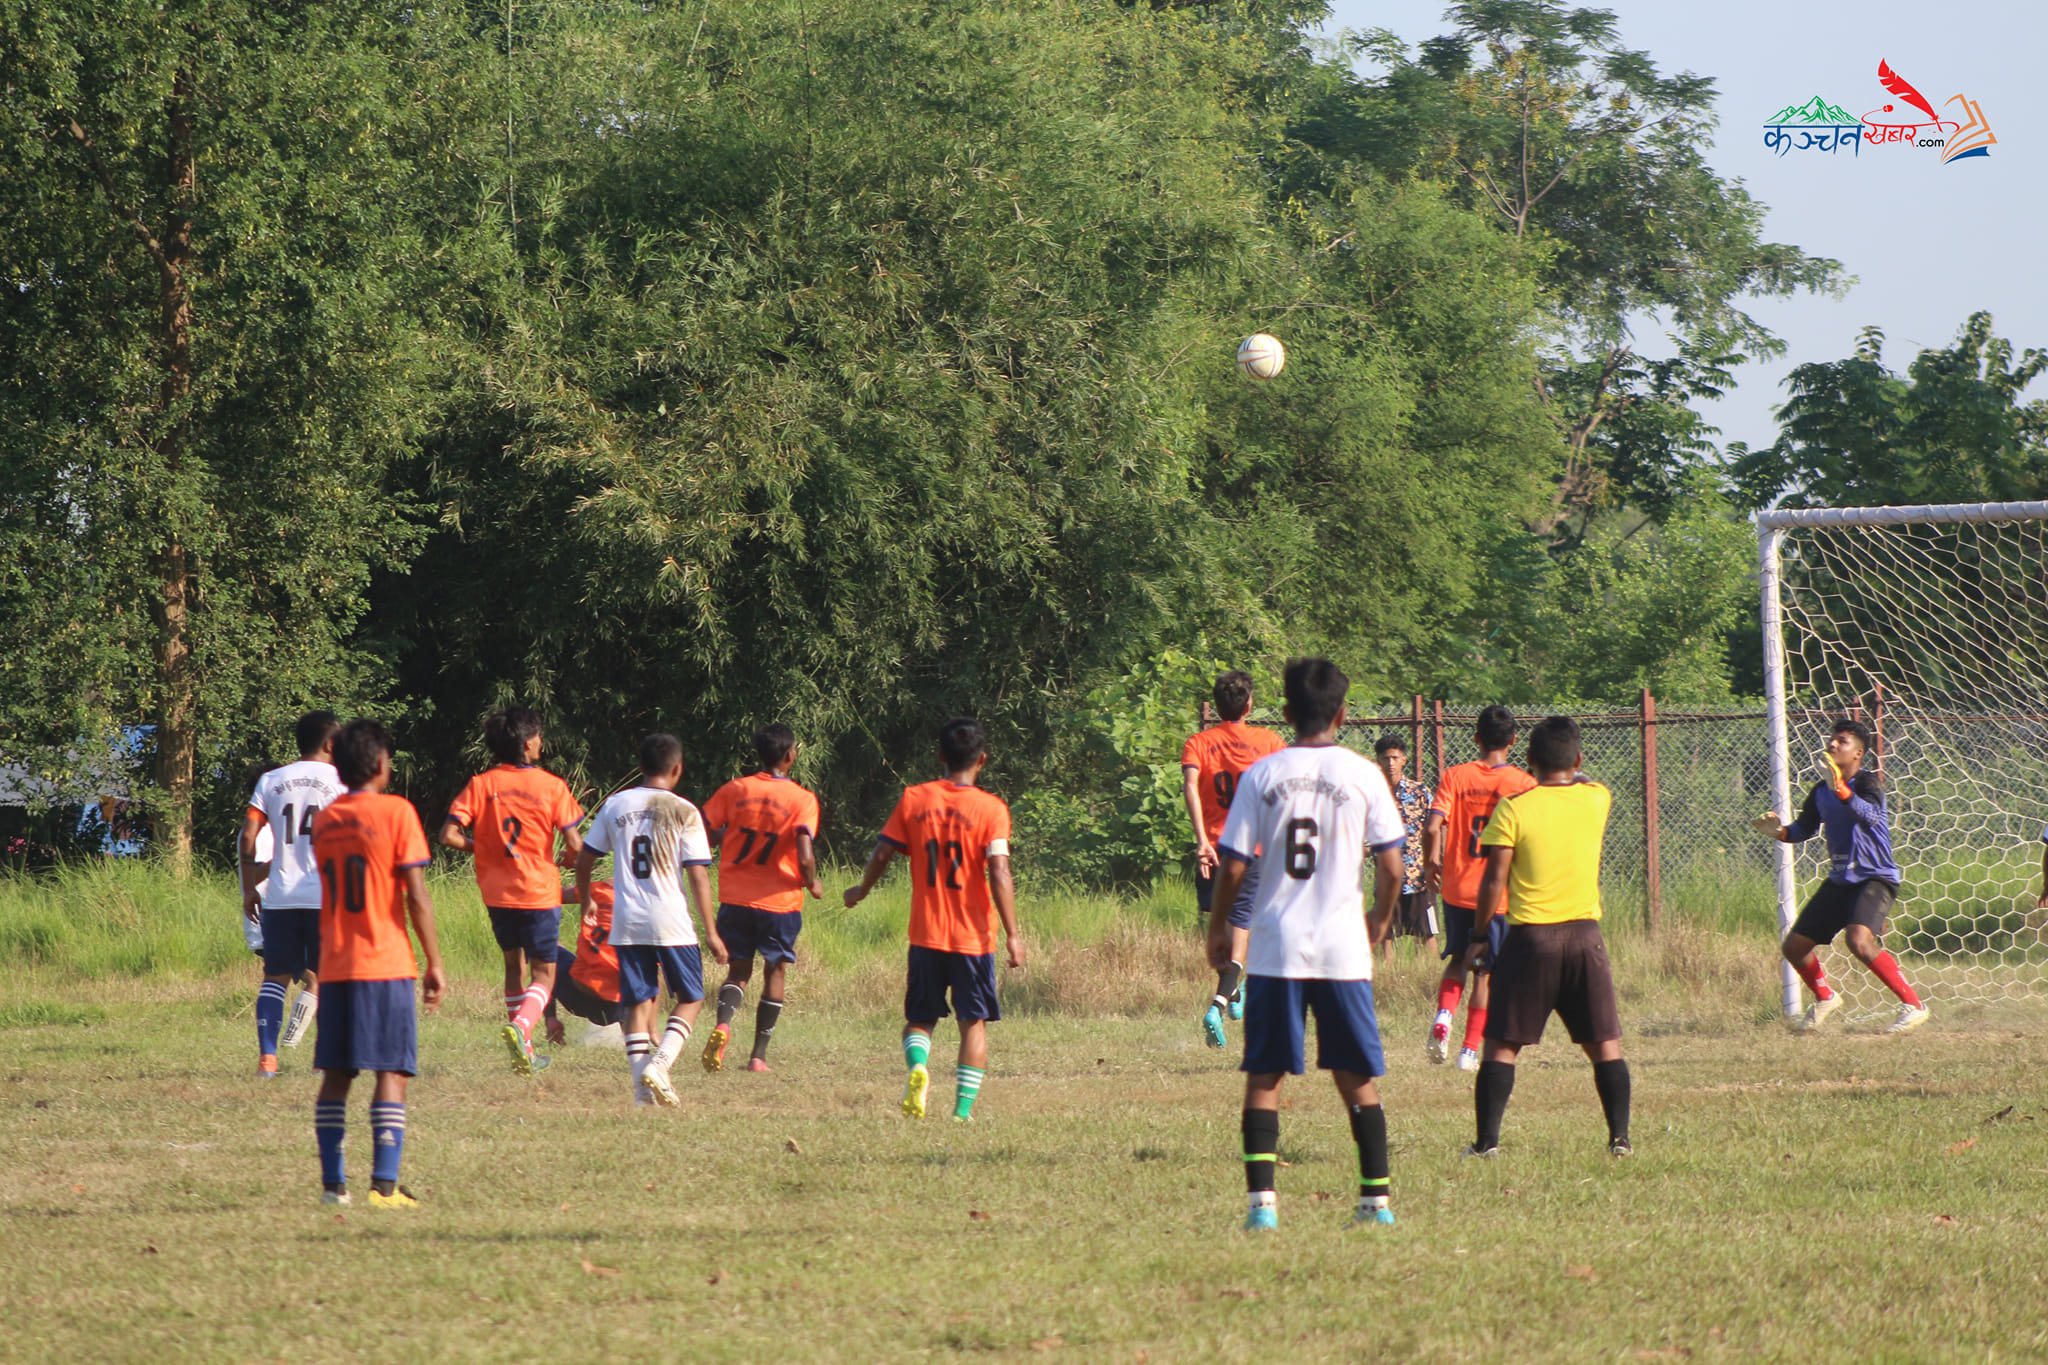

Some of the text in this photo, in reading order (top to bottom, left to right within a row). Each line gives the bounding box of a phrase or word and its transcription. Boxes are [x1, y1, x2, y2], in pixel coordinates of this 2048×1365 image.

[1214, 771, 1242, 810] 9
[282, 803, 320, 845] 14
[503, 816, 521, 858] 2
[632, 834, 653, 879] 8
[927, 838, 963, 890] 12
[1285, 817, 1318, 880] 6
[323, 854, 366, 913] 10
